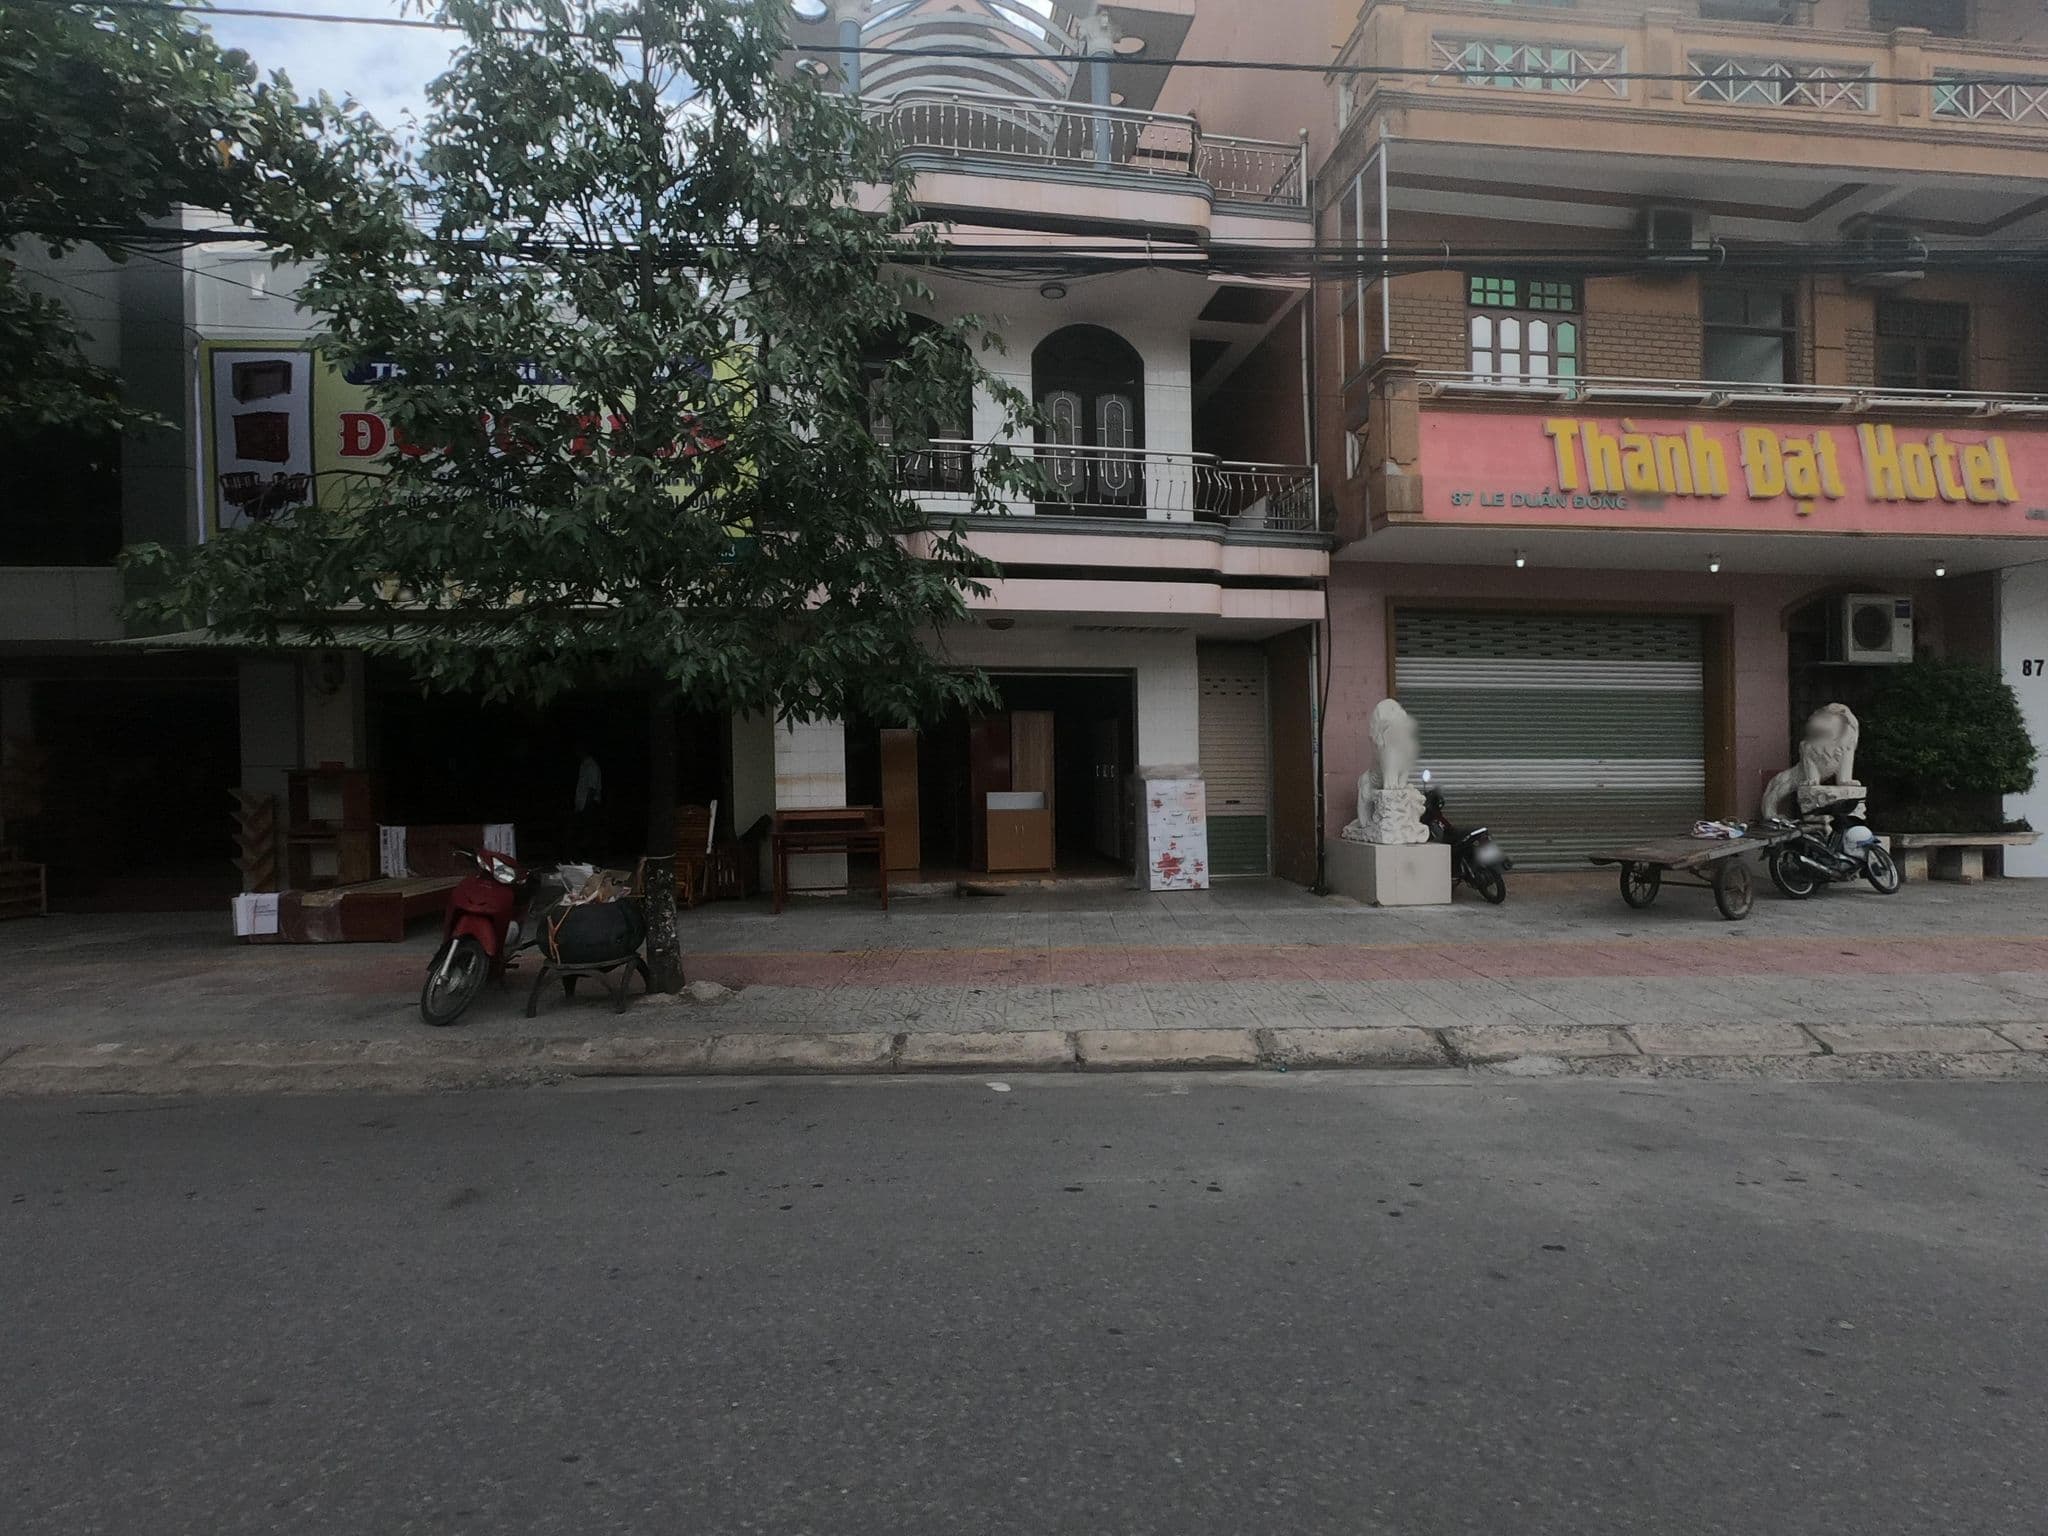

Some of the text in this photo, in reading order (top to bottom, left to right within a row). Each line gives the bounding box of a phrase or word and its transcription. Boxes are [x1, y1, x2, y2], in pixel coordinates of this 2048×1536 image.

[1545, 418, 2020, 516] Thành Đạt Hotel
[1451, 491, 1474, 506] 87
[2022, 659, 2045, 677] 87
